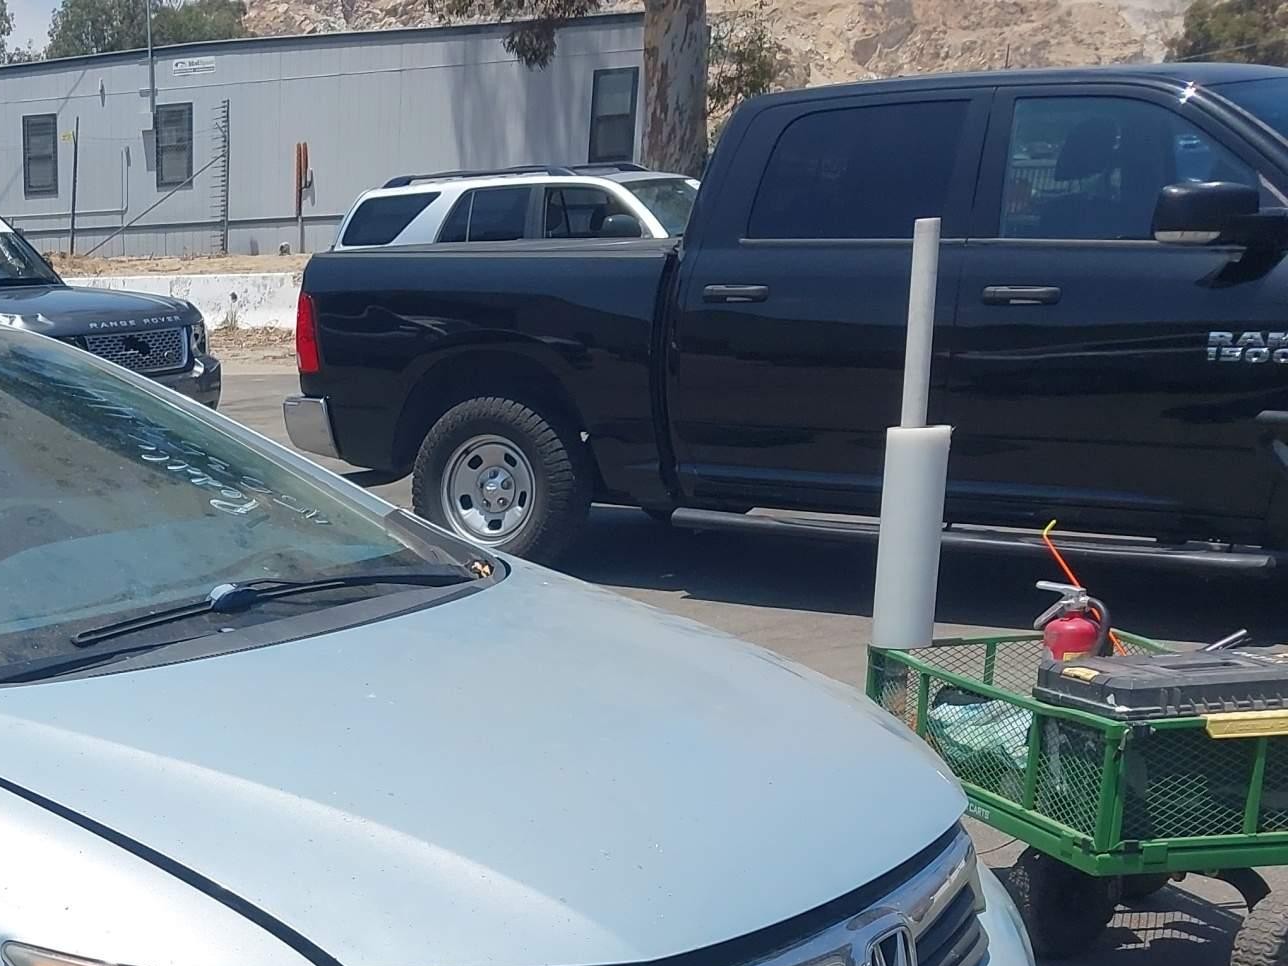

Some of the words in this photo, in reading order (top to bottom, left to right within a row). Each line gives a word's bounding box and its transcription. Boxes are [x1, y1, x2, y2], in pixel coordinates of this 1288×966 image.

[89, 319, 136, 329] RANGE
[143, 315, 181, 325] ROVER
[969, 803, 990, 819] CARTS
